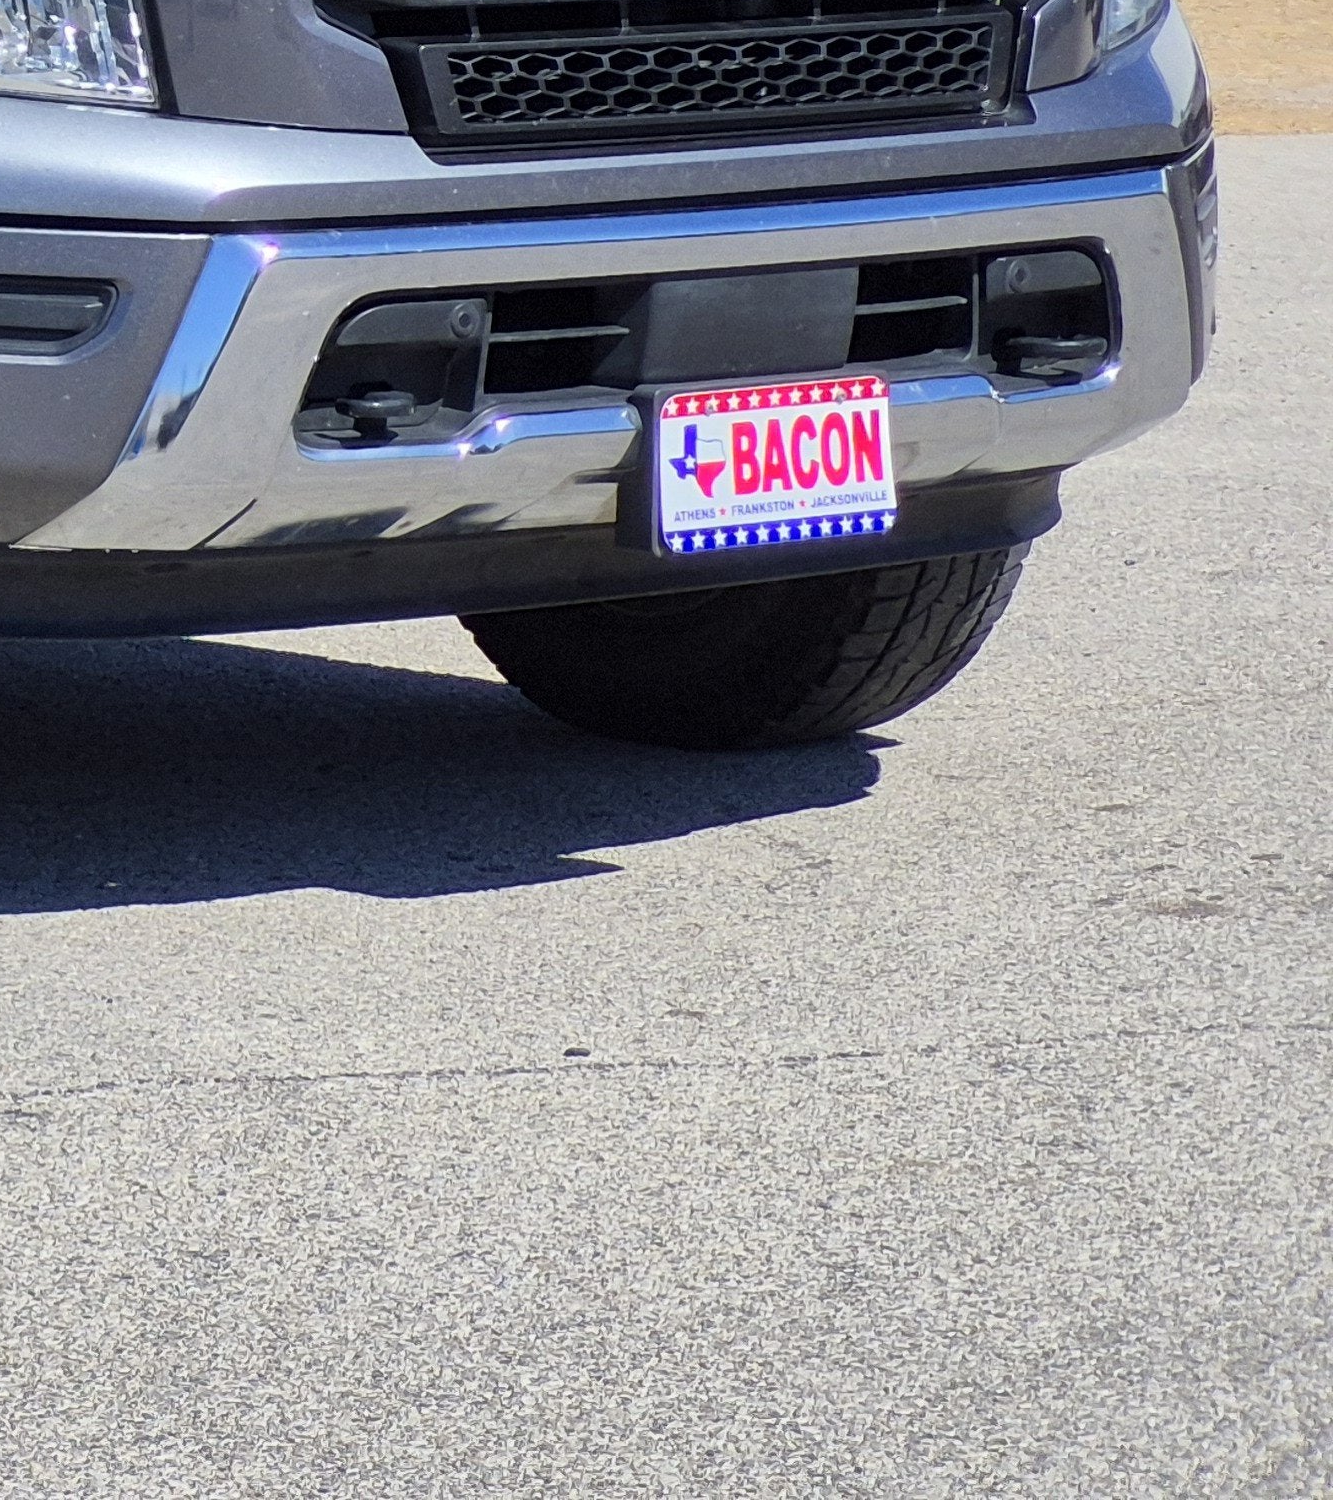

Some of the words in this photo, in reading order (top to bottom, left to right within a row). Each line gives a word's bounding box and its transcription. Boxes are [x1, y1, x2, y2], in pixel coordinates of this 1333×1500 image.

[731, 409, 884, 496] BACON
[673, 506, 717, 523] ATHENS
[730, 499, 795, 517] FRANKSTON
[810, 489, 888, 509] JACKSONVILLE
